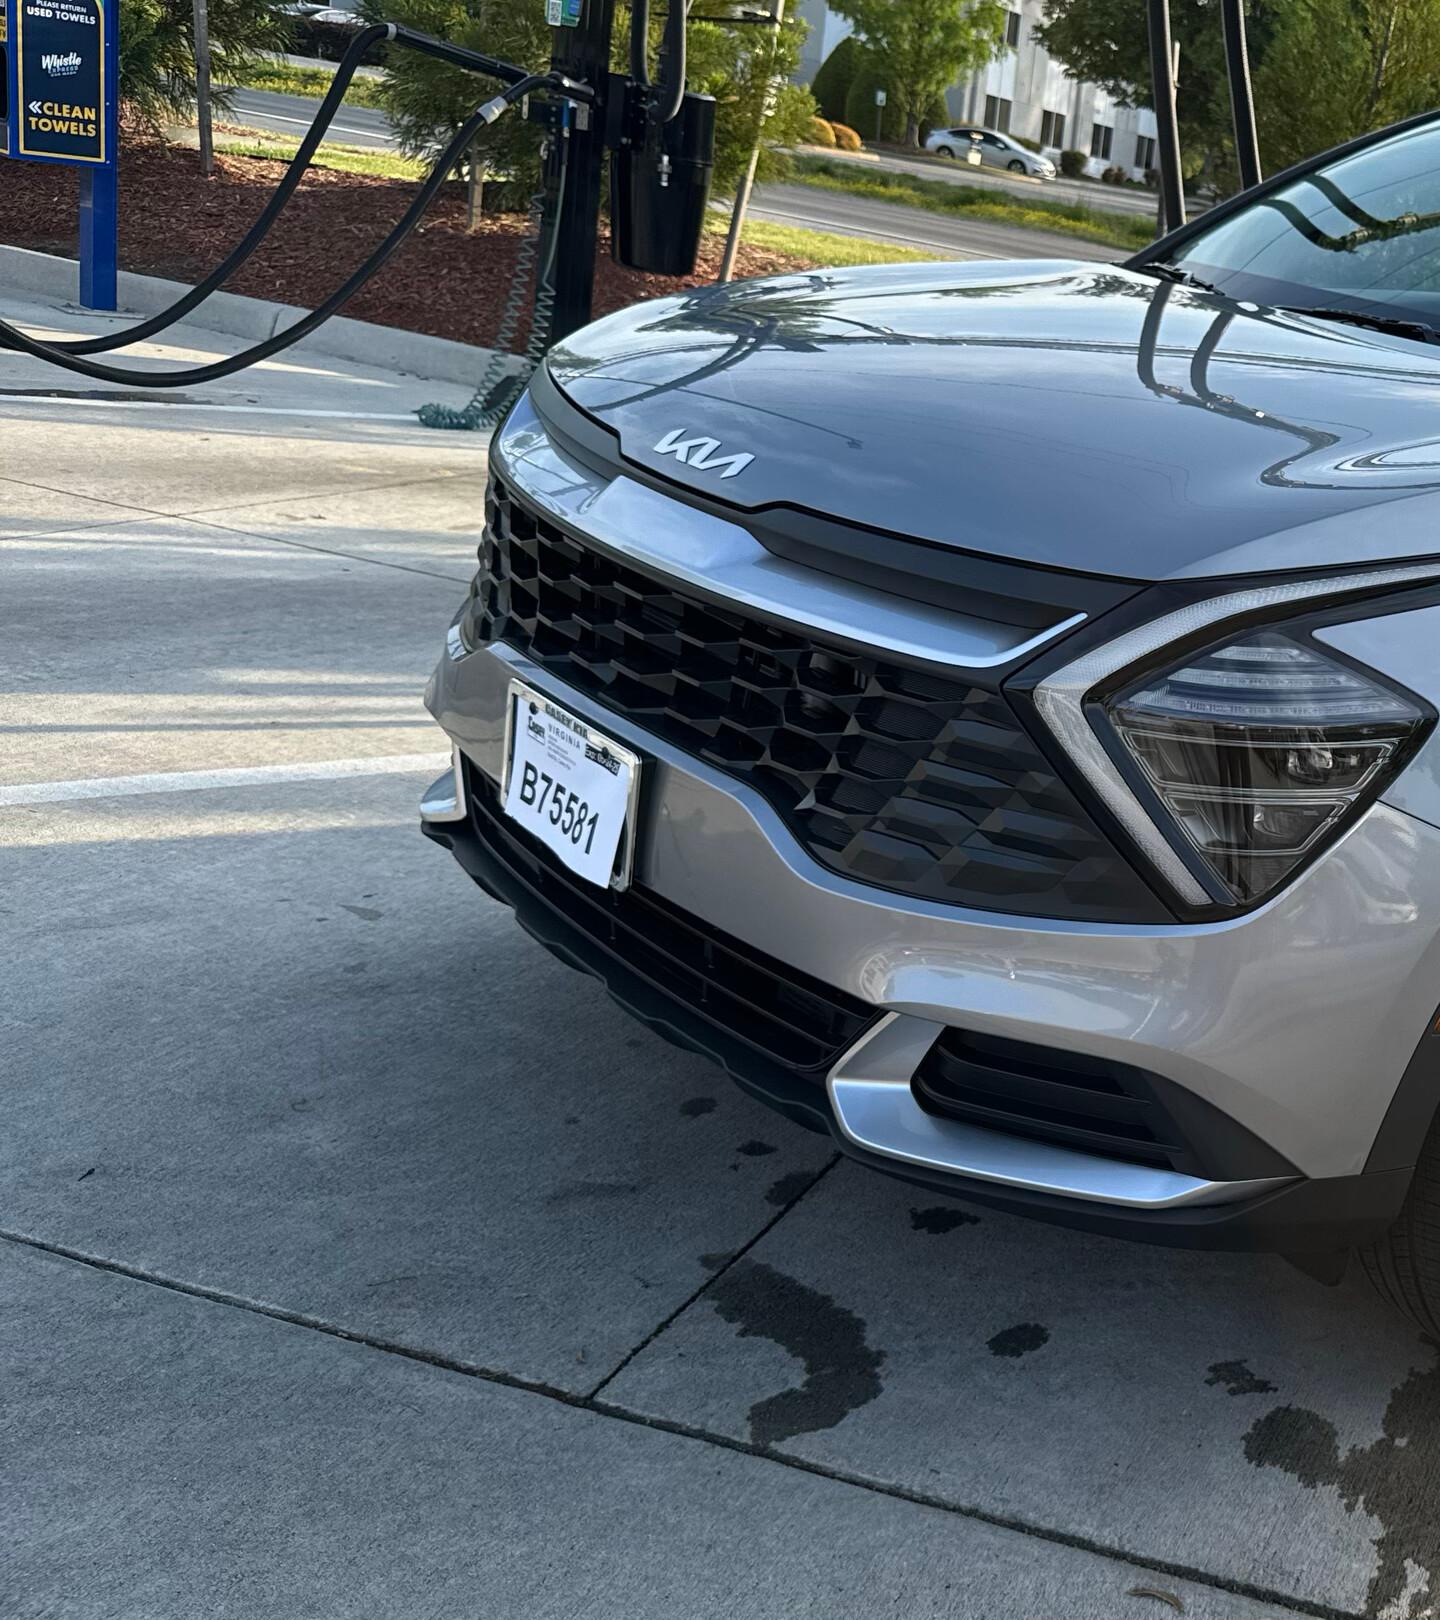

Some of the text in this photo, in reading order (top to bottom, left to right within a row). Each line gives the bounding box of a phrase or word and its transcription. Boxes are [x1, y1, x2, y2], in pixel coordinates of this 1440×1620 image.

[27, 6, 96, 25] USED TOWELS
[36, 0, 87, 13] PLEASE RETURN
[41, 52, 82, 70] Whistle
[43, 102, 96, 120] CLEAN
[28, 116, 97, 137] TOWELS
[653, 427, 756, 480] KIA
[547, 724, 580, 750] VIRGINIA
[520, 760, 600, 856] B75581
